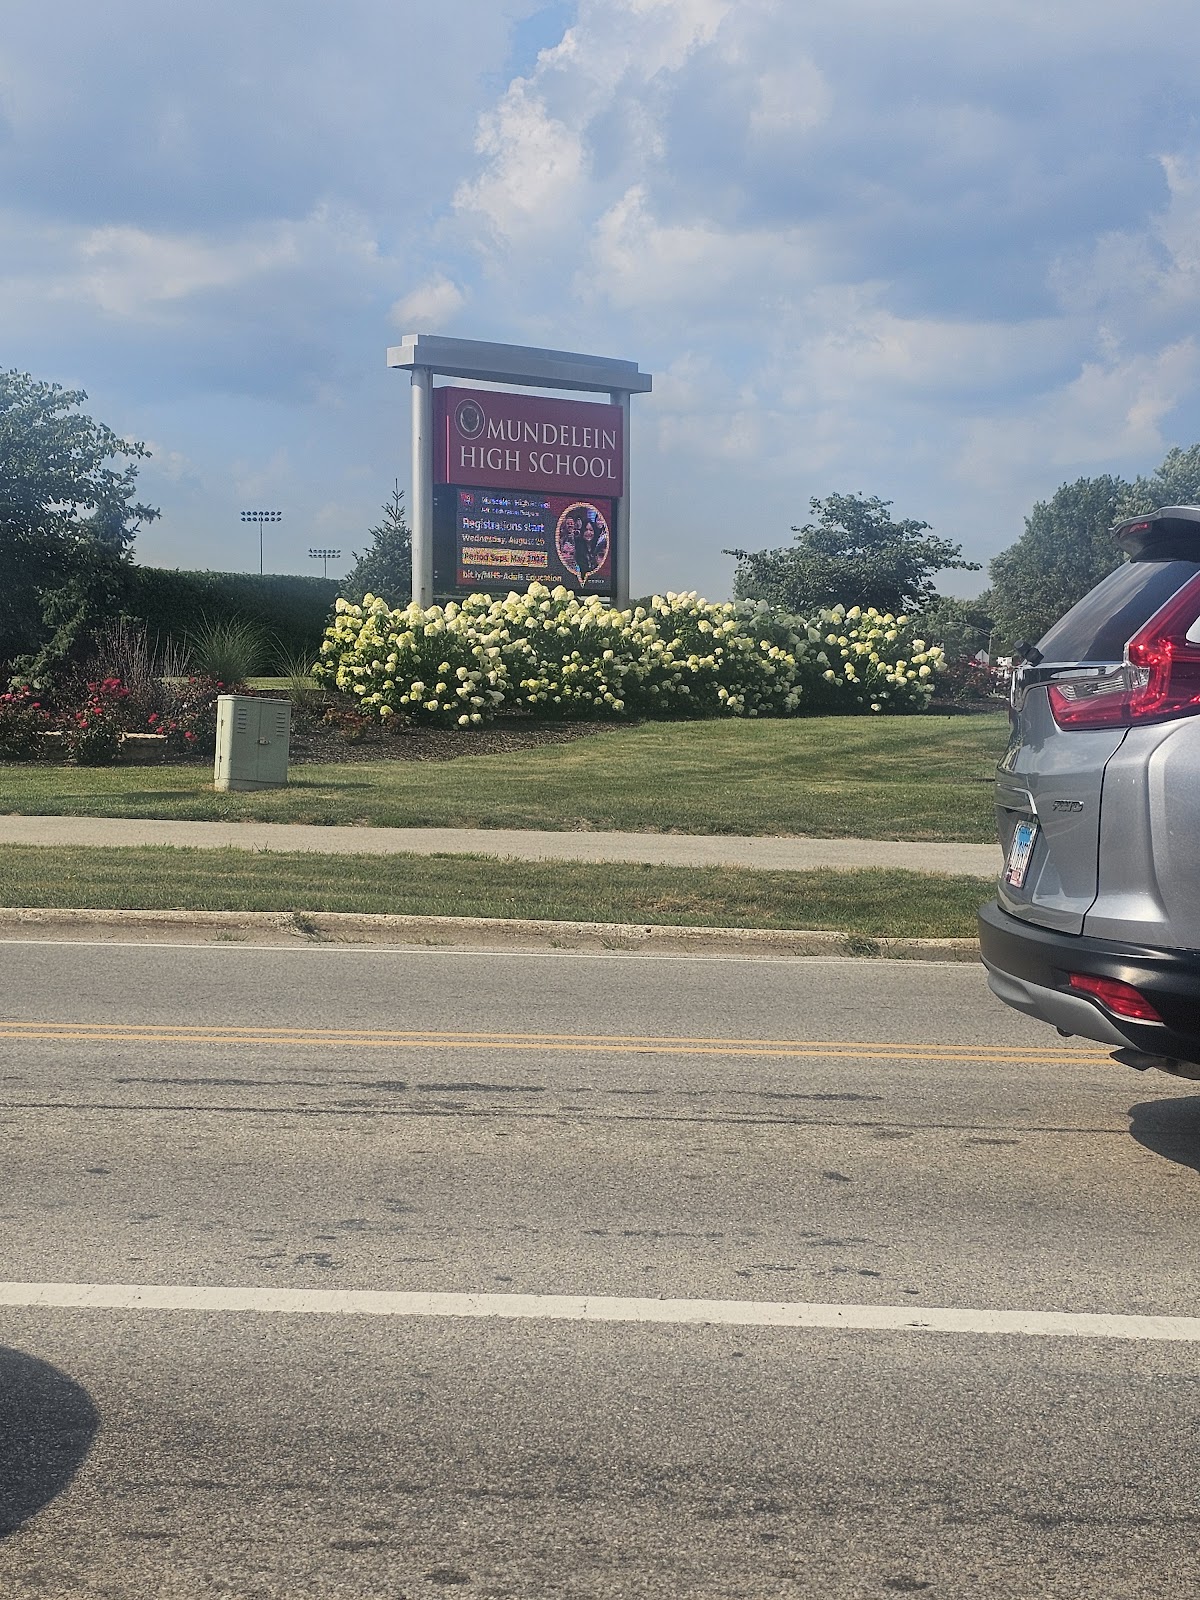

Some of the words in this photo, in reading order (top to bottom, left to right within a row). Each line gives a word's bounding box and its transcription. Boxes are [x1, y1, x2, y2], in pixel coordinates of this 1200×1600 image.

[487, 417, 616, 450] MUNDELEIN
[460, 445, 520, 472] HIGH
[529, 451, 616, 479] SCHOOL
[462, 517, 523, 531] Registrations
[525, 523, 545, 533] start
